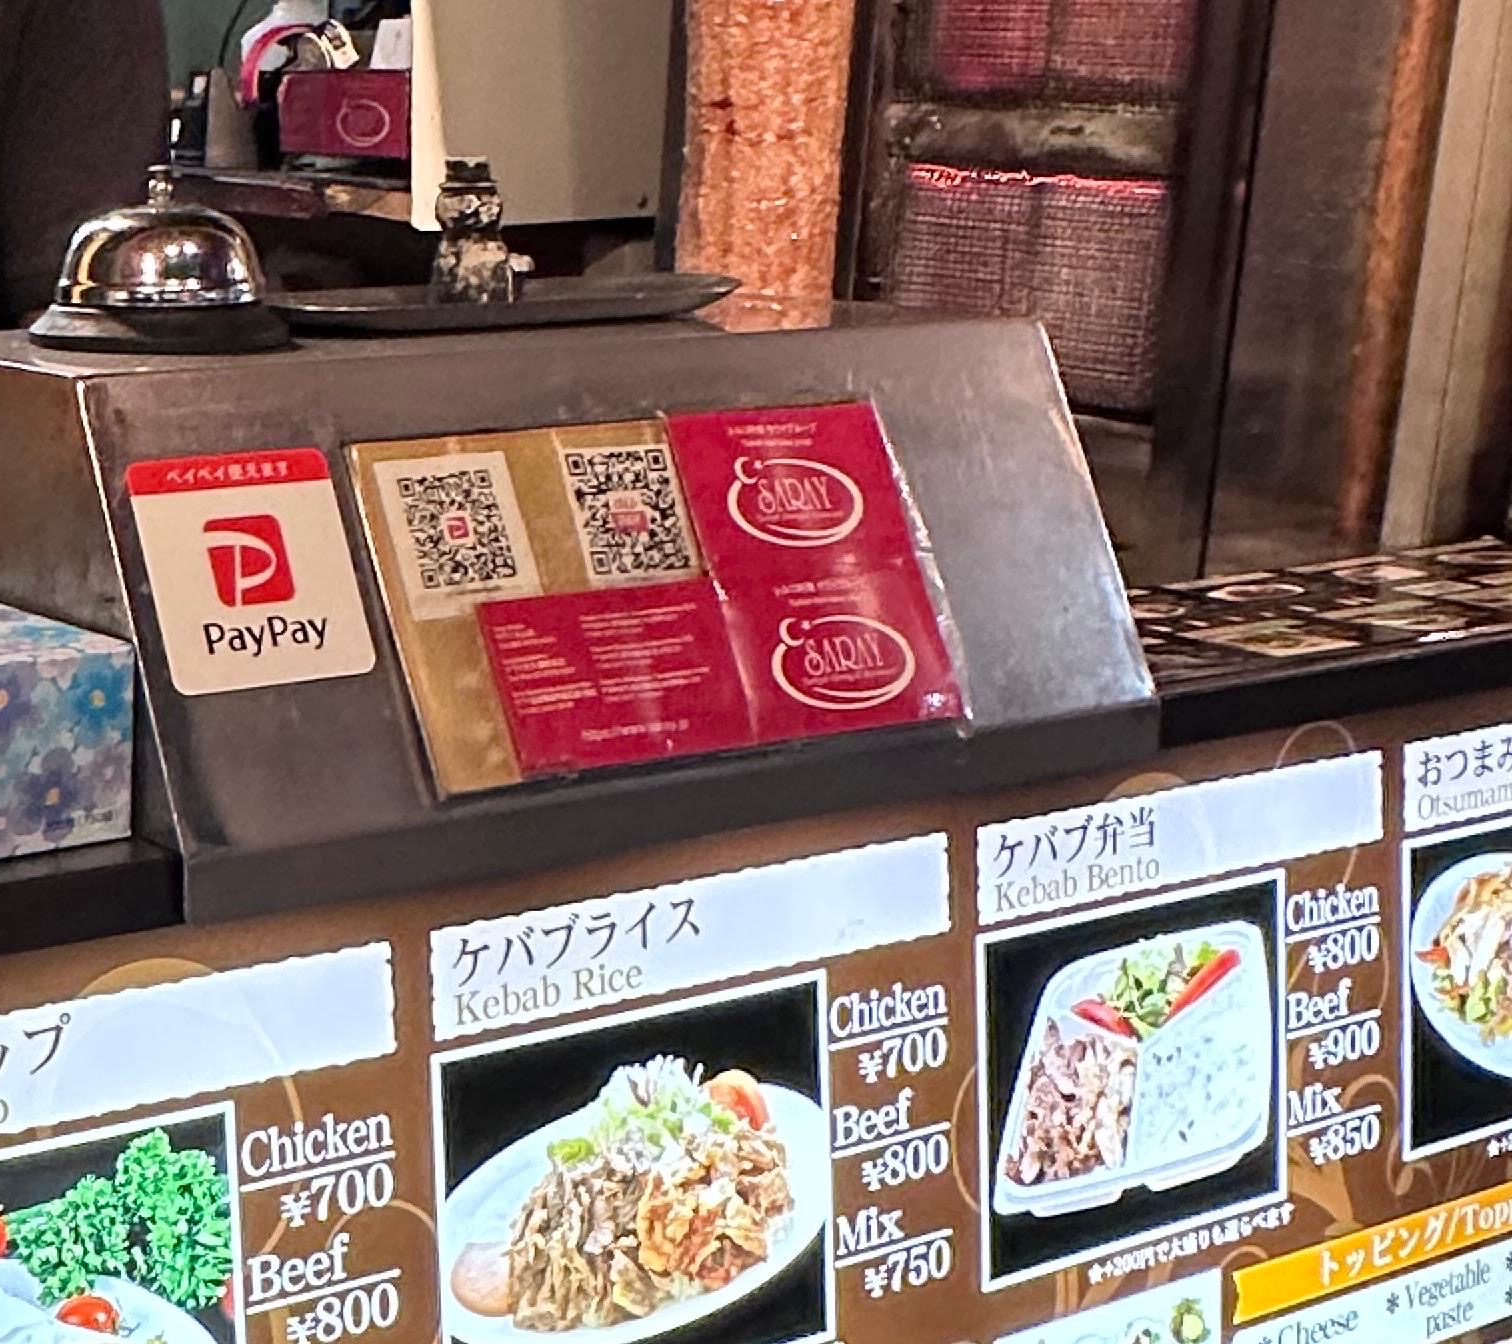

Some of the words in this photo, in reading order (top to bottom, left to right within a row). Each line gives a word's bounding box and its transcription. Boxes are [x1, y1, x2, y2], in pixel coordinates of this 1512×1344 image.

[757, 477, 832, 513] SARAY
[202, 615, 328, 657] PayPay
[804, 632, 884, 676] SARAY
[993, 806, 1154, 879] ケバブ弁当
[994, 869, 1078, 912] Kebab
[1087, 856, 1160, 892] Bento
[1286, 884, 1380, 930] Chicken
[451, 896, 702, 986] ケバブライス
[1307, 926, 1380, 973] ¥800
[454, 982, 562, 1026] Kebab
[573, 963, 644, 1003] Rice
[828, 982, 947, 1036] Chicken
[1288, 979, 1353, 1027] Beef
[858, 1026, 947, 1081] ¥700
[1308, 1020, 1380, 1070] ¥900
[832, 1088, 914, 1145] Beef
[1288, 1084, 1343, 1127] Mix
[241, 1112, 392, 1177] Chicken
[861, 1132, 949, 1190] ¥800
[1308, 1105, 1380, 1164] ¥850
[280, 1164, 395, 1228] ¥700
[835, 1205, 903, 1255] Mix
[248, 1235, 351, 1303] Beef
[863, 1239, 951, 1296] ¥750
[1405, 1258, 1491, 1309] Vegetable
[1425, 1301, 1474, 1339] paste
